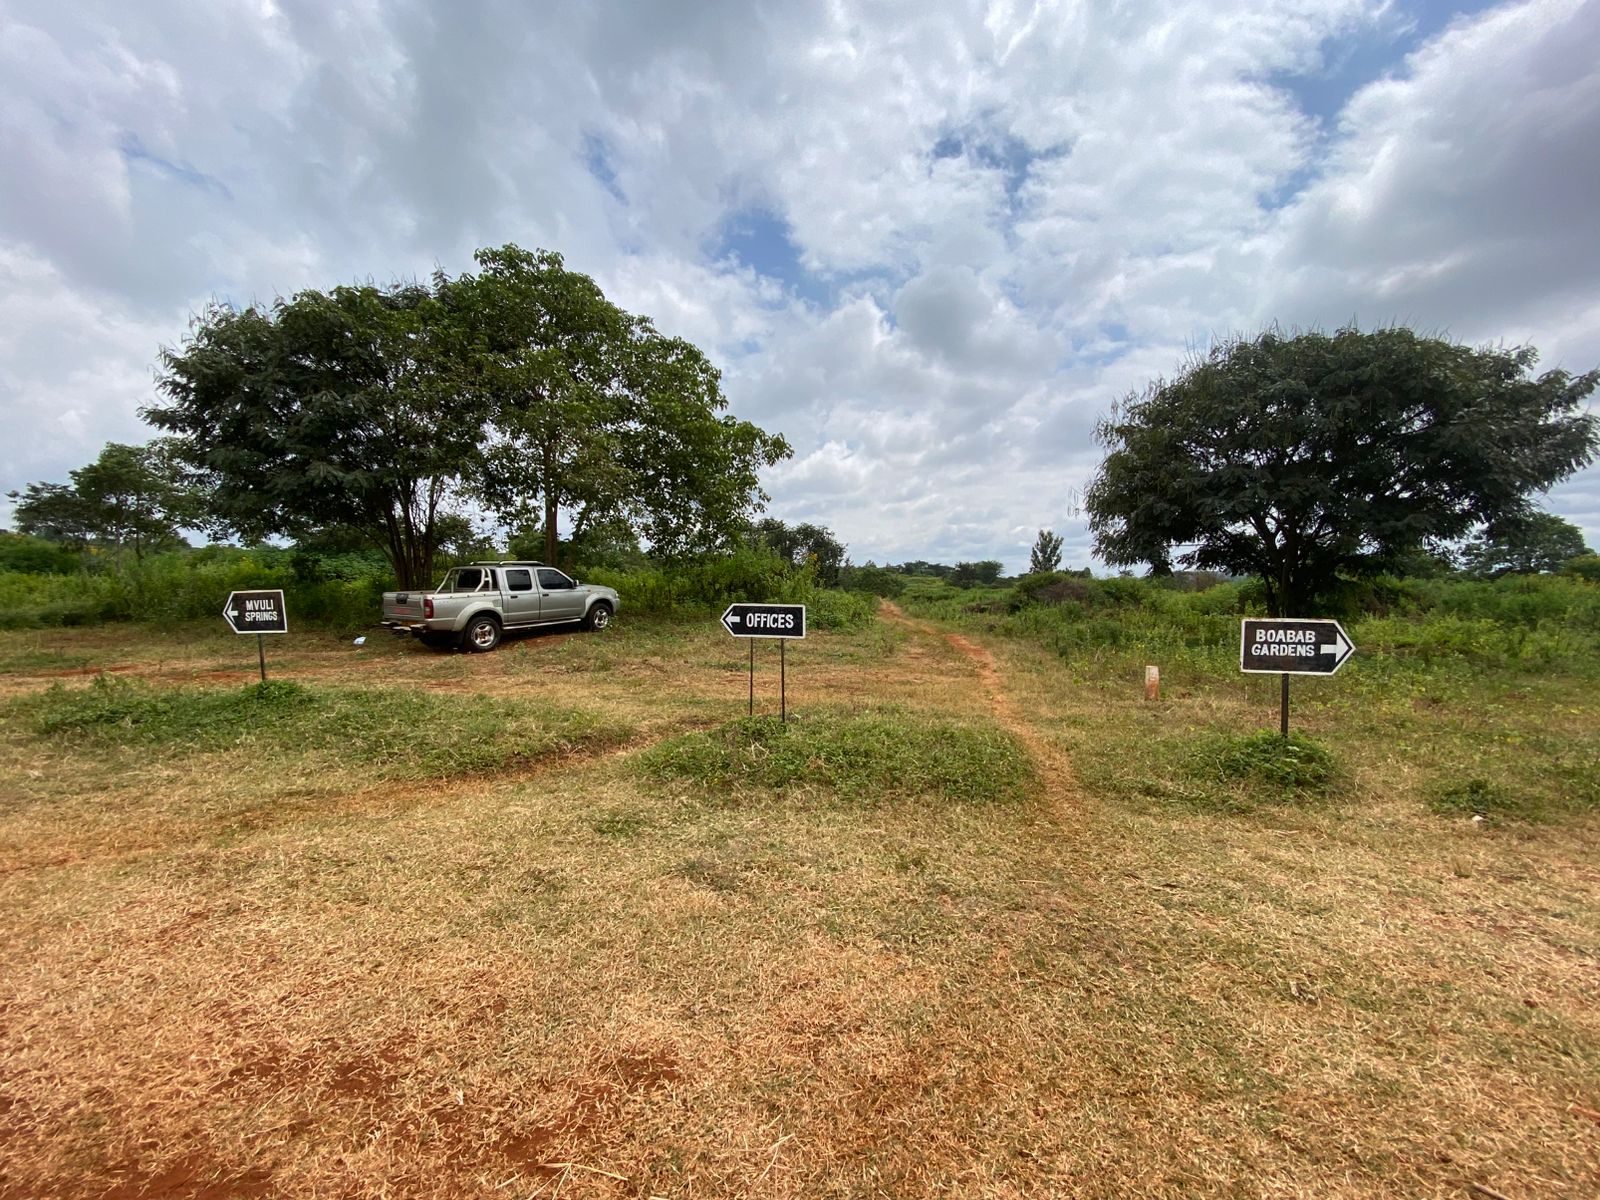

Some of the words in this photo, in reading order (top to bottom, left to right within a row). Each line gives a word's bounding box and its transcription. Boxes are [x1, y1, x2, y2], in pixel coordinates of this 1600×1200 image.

[245, 599, 274, 611] MVULI
[245, 611, 278, 622] SPRINGS
[746, 613, 794, 629] OFFICES
[1255, 629, 1316, 643] BOABAB
[1251, 644, 1315, 657] GARDENS
